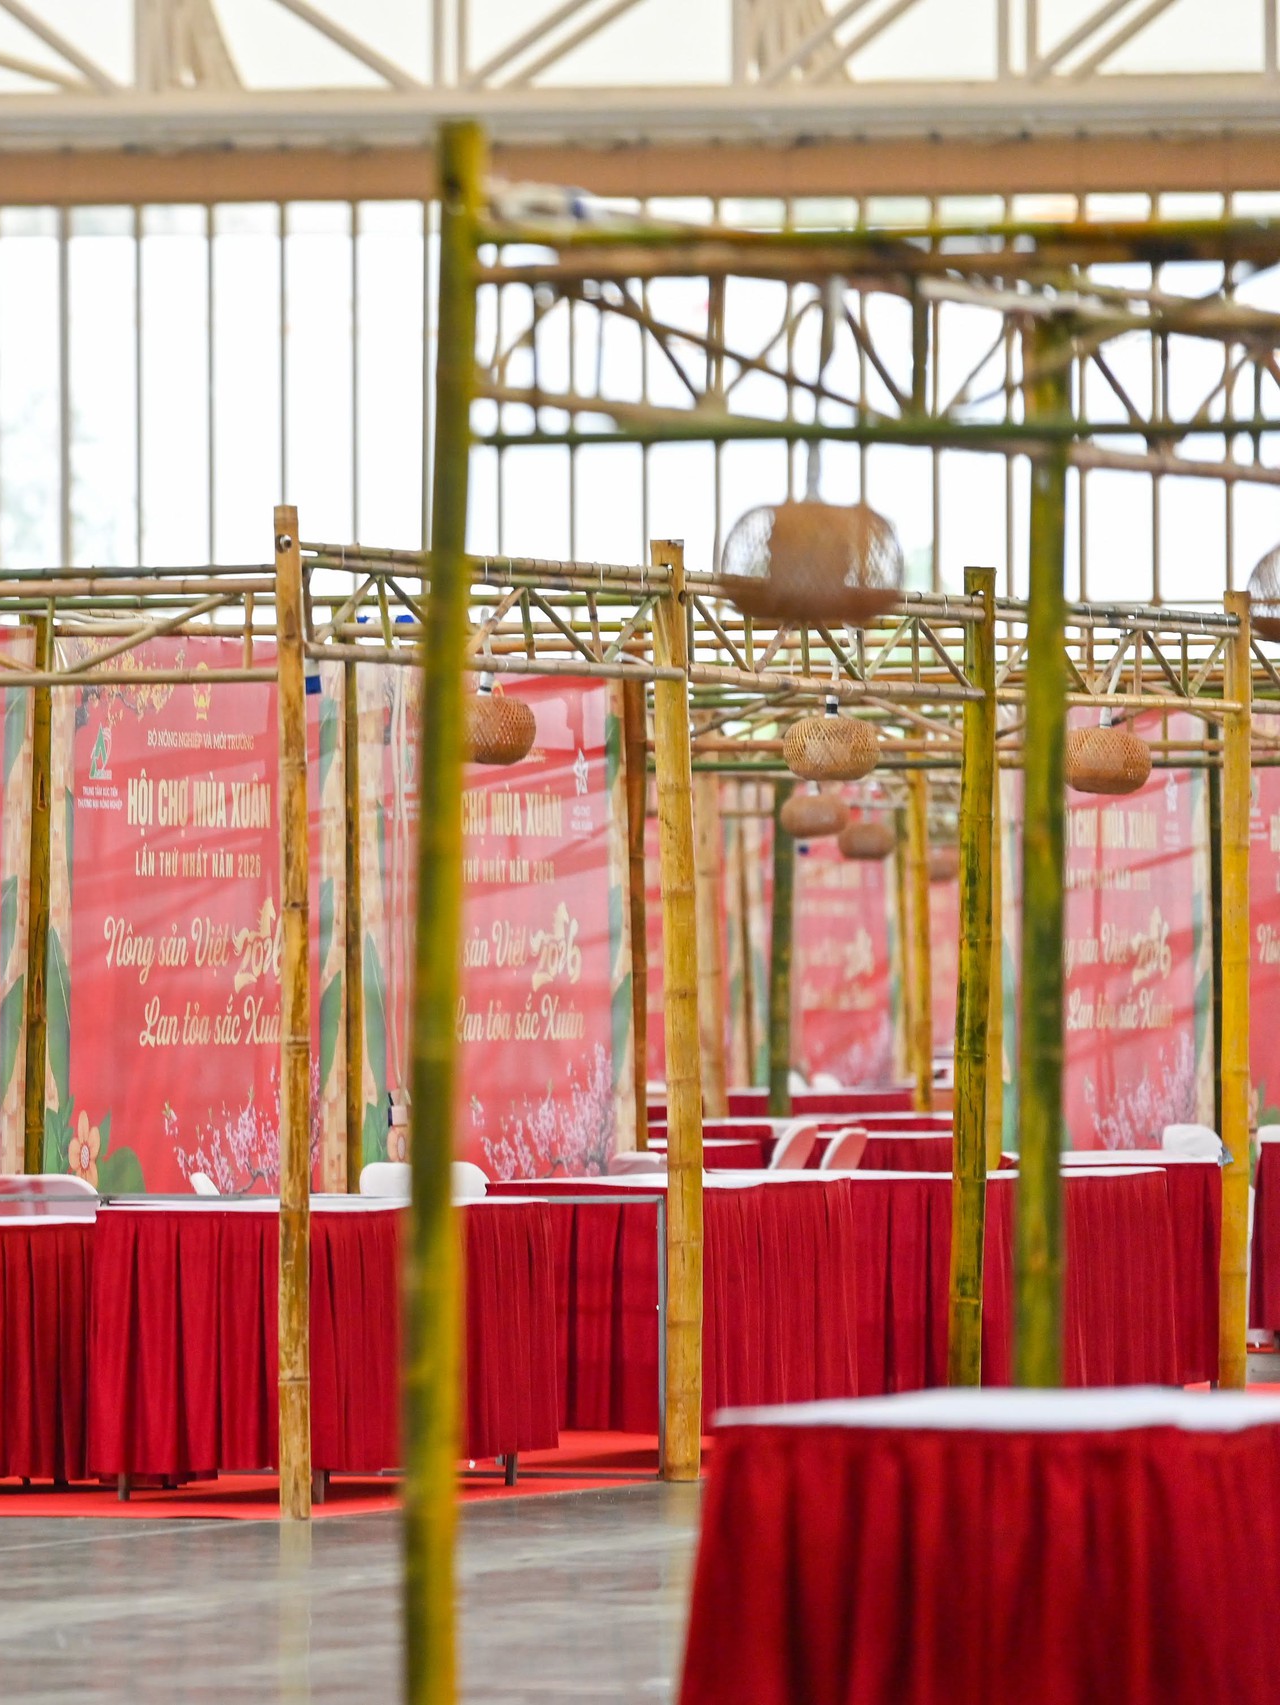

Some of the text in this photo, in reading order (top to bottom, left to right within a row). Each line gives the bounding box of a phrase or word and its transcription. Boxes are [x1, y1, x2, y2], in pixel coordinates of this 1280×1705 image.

[148, 729, 157, 748] BỘ
[158, 730, 176, 747] NÔNG
[127, 768, 270, 837] HỘI CHỢ MÙA XUÂN
[462, 783, 562, 845] CHỢ MÙA XUÂN
[135, 843, 261, 878] LẦN THỨ NHẤT NĂM 2026
[103, 916, 155, 985] Nông
[158, 923, 189, 967] sản
[191, 917, 229, 977] Việt
[463, 902, 582, 992] sản Việt 2026
[139, 993, 281, 1048] Lan tỏa sắc Xuâ
[487, 1000, 511, 1041] tỏa
[515, 992, 540, 1041] sắc
[541, 993, 585, 1041] Xuân
